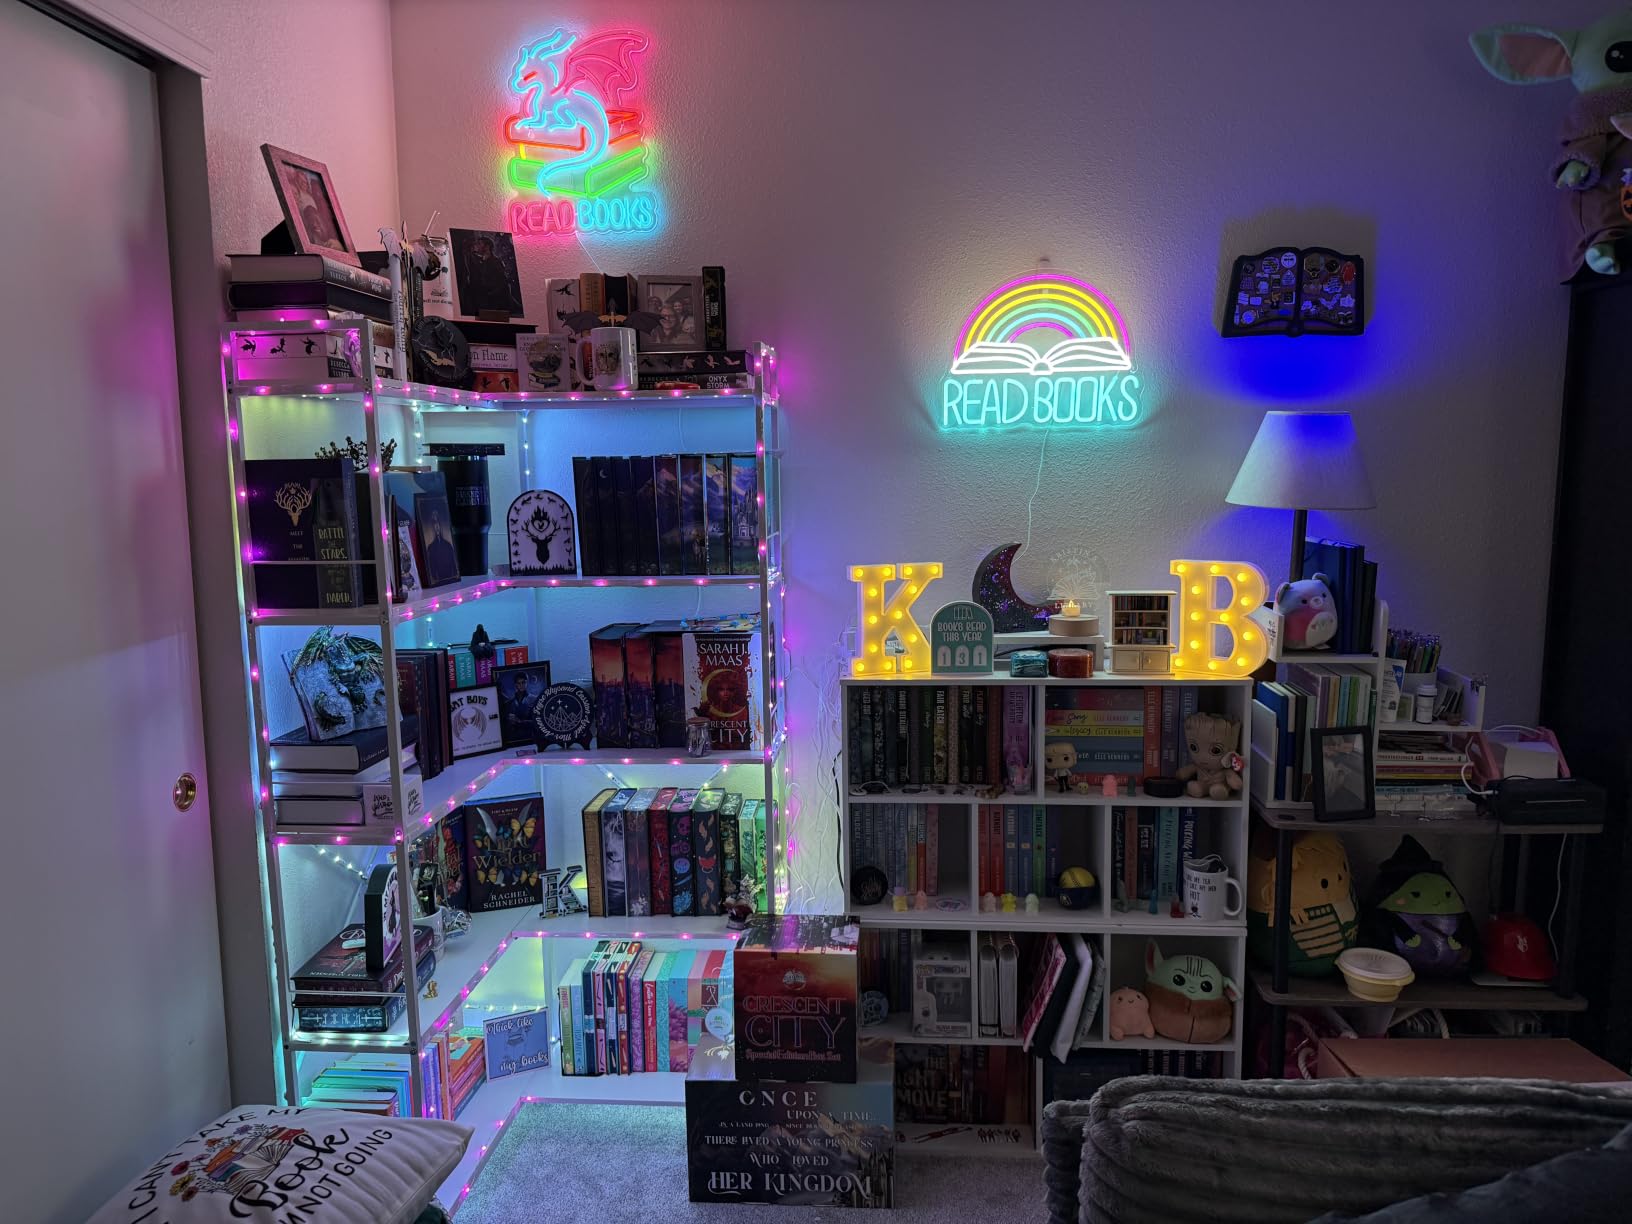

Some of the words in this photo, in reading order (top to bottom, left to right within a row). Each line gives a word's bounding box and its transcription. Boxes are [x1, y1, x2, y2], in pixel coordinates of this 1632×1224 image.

[511, 201, 575, 232] READ
[577, 197, 652, 230] BOOKS
[481, 349, 509, 361] Flame
[708, 375, 728, 383] ONYX
[943, 378, 1029, 426] READ
[1033, 375, 1139, 423] BOOKS
[847, 562, 944, 677] K
[937, 621, 963, 632] BOOKS
[966, 621, 987, 632] READ
[1170, 559, 1269, 678] B
[943, 631, 960, 642] THIS
[962, 631, 983, 641] YEAR
[700, 643, 738, 654] SARAH
[741, 643, 748, 656] J.
[705, 655, 743, 666] MAAS
[544, 685, 577, 697] Rhysand
[936, 690, 945, 704] FAIR
[466, 695, 489, 706] BOYS
[936, 705, 945, 724] CATCH
[709, 720, 749, 729] RESCENT
[472, 850, 541, 869] Wielder
[483, 896, 536, 909] SCHNEIDER
[491, 890, 528, 902] RACHEL
[743, 995, 848, 1016] CRESCENT
[517, 1016, 534, 1028] like
[744, 1015, 848, 1049] CITY
[500, 1061, 516, 1075] my
[521, 1051, 549, 1067] books
[739, 1090, 818, 1107] ONCE
[896, 1089, 948, 1108] MOVE
[787, 1109, 819, 1120] UPON
[176, 1111, 257, 1150] TAKE
[705, 1135, 738, 1146] THERE
[742, 1136, 770, 1146] LIVED
[786, 1137, 821, 1147] YOUNG
[749, 1151, 780, 1168] WHO
[792, 1153, 830, 1167] LOVED
[229, 1127, 350, 1219] Book
[299, 1172, 341, 1216] NOT
[334, 1127, 394, 1180] GOING
[707, 1170, 753, 1197] HER
[764, 1171, 874, 1200] KINGDOM
